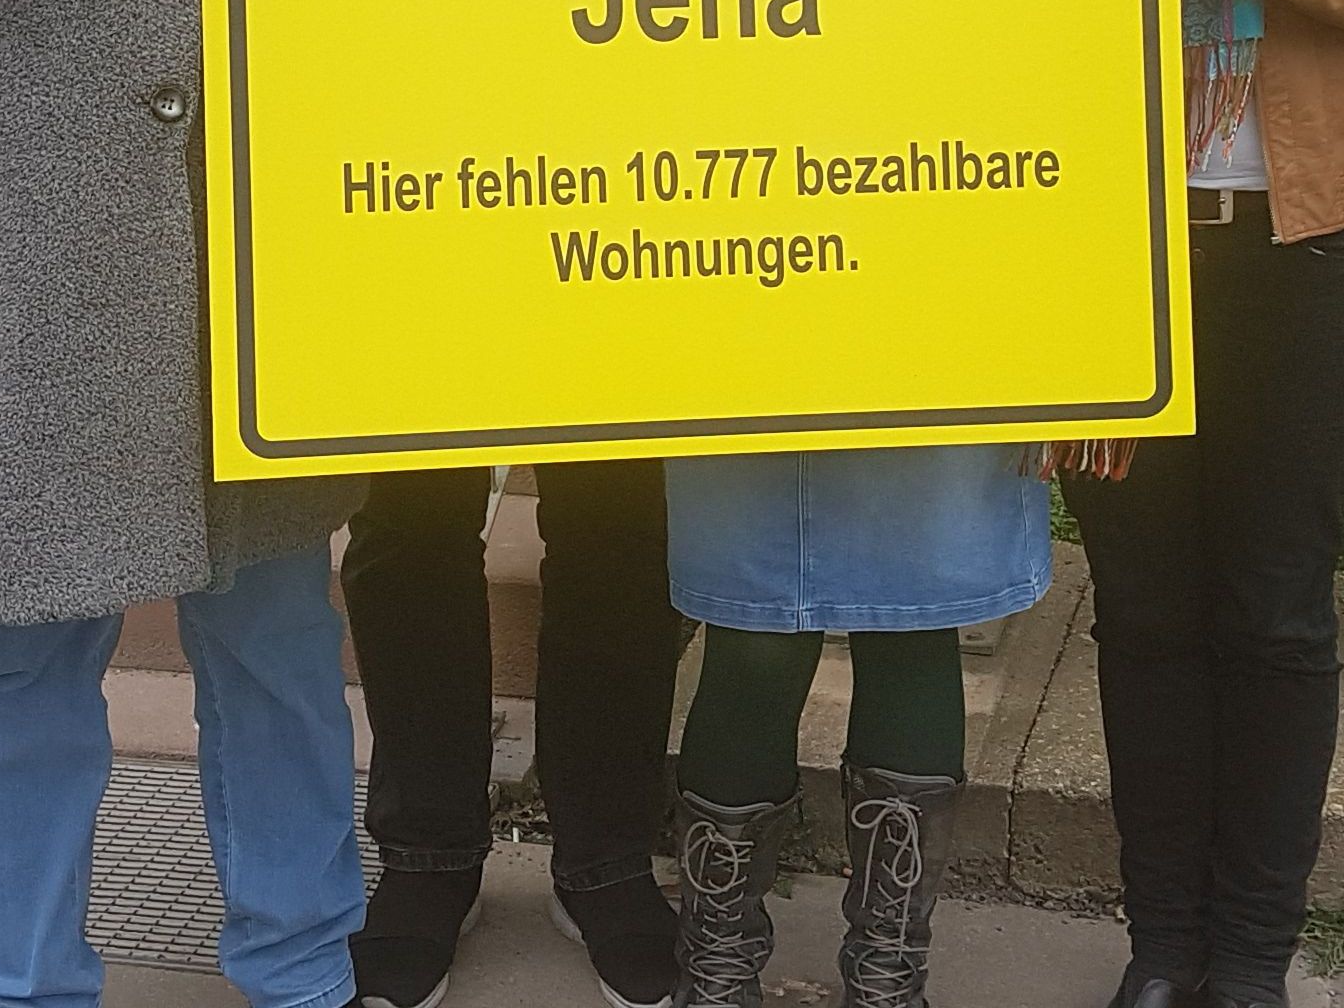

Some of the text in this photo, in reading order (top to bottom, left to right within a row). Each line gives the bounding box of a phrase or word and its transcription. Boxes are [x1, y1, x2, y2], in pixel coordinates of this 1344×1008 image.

[344, 140, 1060, 213] Hier fehlen 10.777 bezahlbare
[551, 228, 858, 288] Wohnungen.
